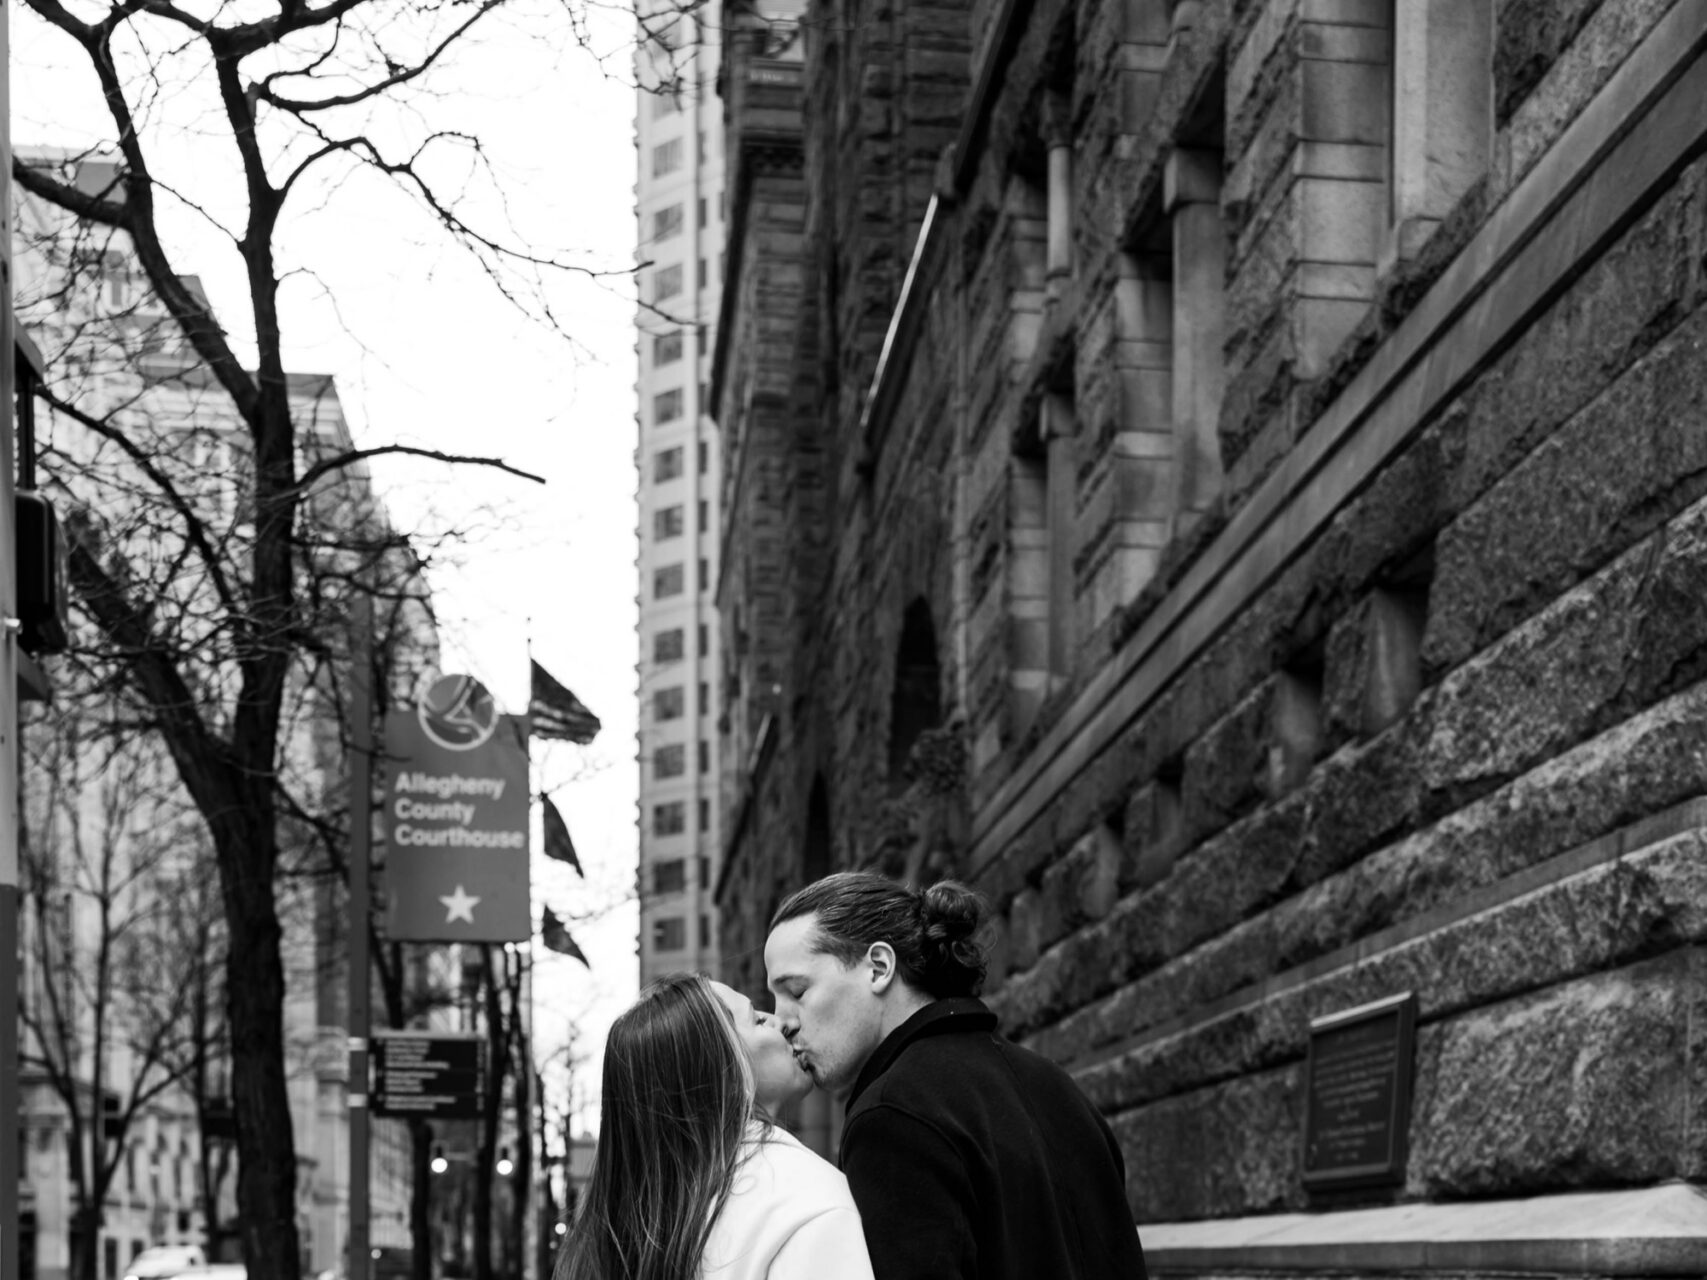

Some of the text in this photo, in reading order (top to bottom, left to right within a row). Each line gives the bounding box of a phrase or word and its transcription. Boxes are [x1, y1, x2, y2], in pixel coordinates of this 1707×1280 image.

[396, 773, 505, 800] Allegheny
[395, 799, 475, 825] County
[395, 825, 525, 848] Courthouse
